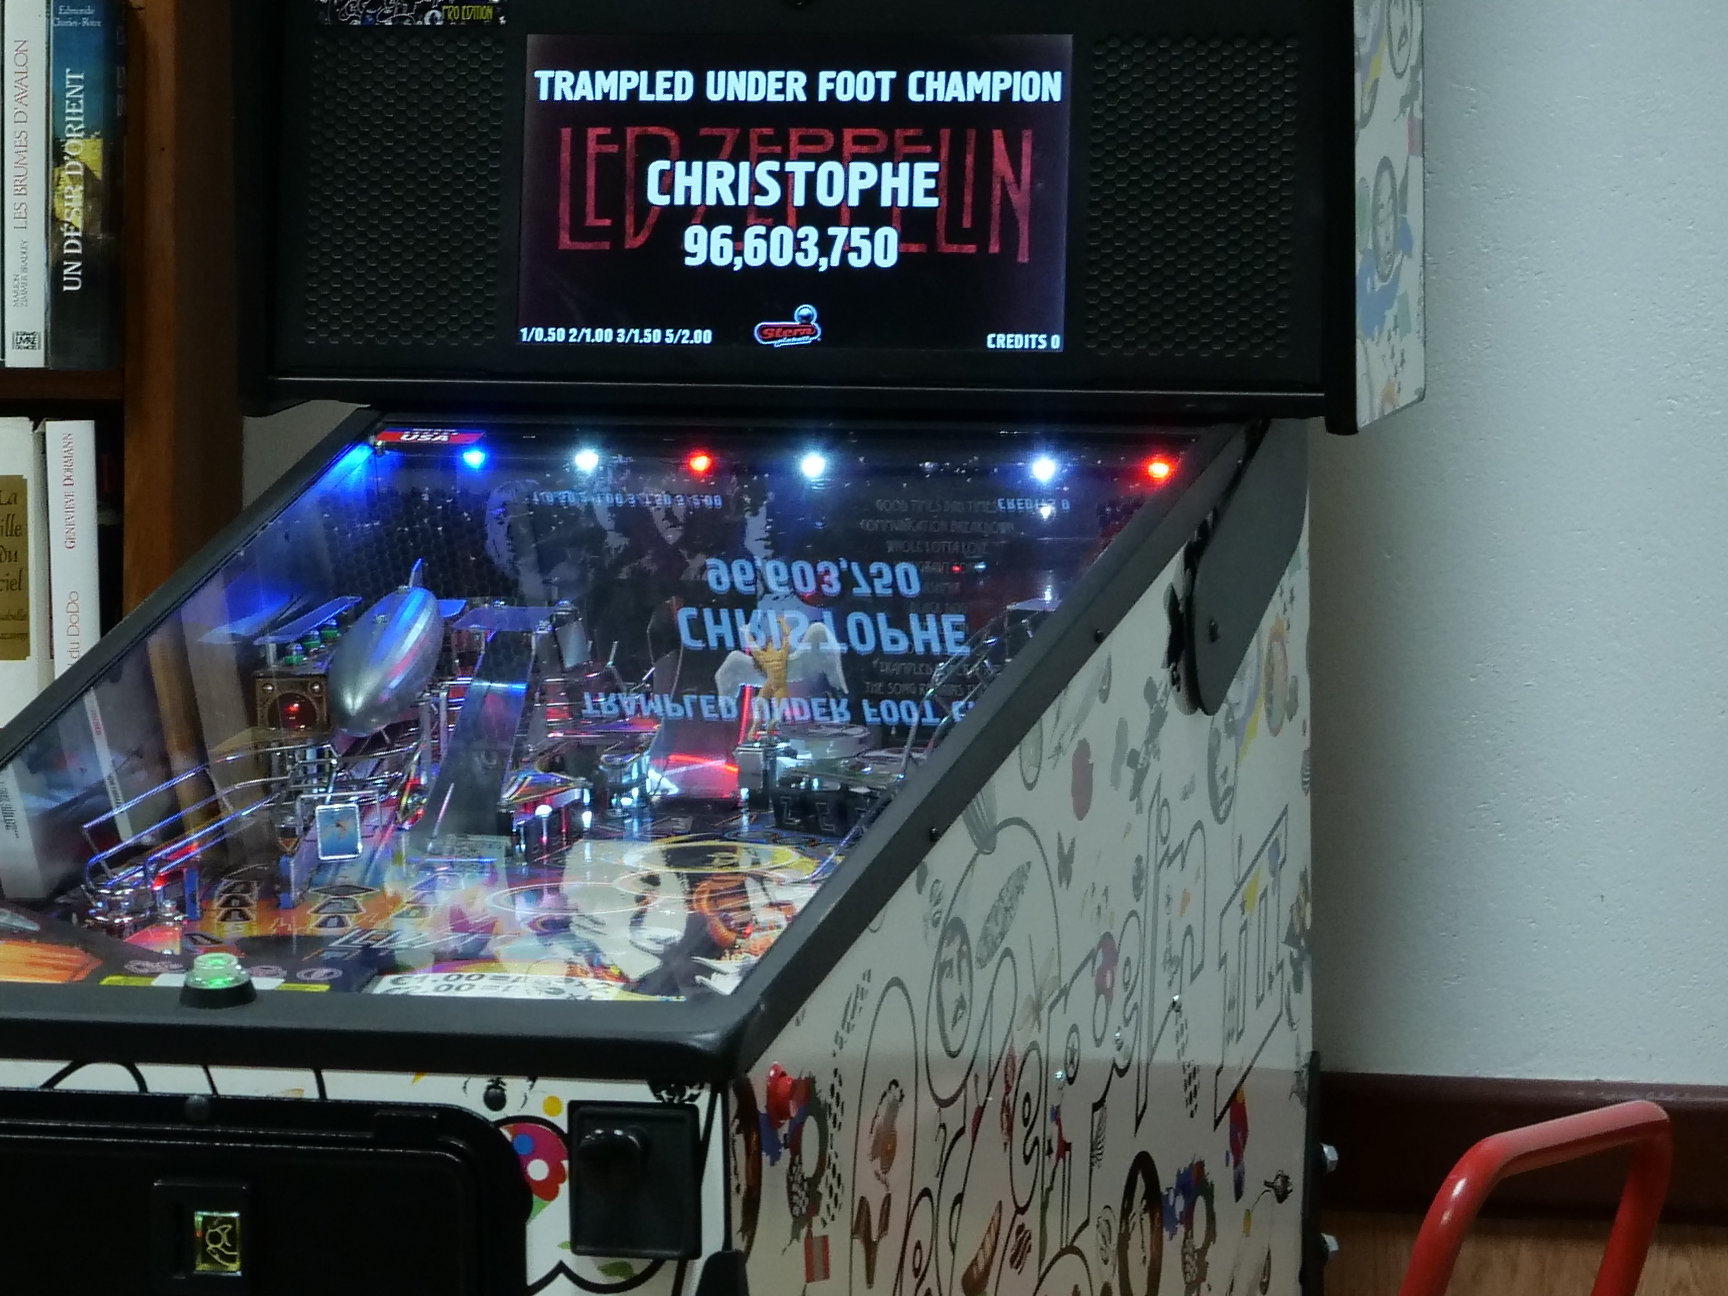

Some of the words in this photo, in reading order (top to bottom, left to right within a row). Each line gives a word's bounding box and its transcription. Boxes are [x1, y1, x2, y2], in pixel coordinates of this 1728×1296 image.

[462, 5, 493, 20] EDITION
[535, 69, 694, 102] TRAMPLED
[705, 70, 807, 102] UNDER
[817, 70, 896, 103] FOOT
[907, 70, 1062, 103] CHAMPION
[62, 68, 85, 176] D'ORIENT
[646, 159, 940, 207] CHRISTOPHE
[61, 184, 84, 254] DÉSIR
[683, 225, 899, 272] 96,603,750
[62, 261, 82, 291] UN
[520, 327, 565, 345] 1/0.50
[568, 328, 613, 345] 2/1.00
[616, 328, 662, 345] 3/1.50
[664, 328, 713, 346] 5/2.00
[986, 332, 1047, 350] CREDITS
[1050, 333, 1061, 350] 0
